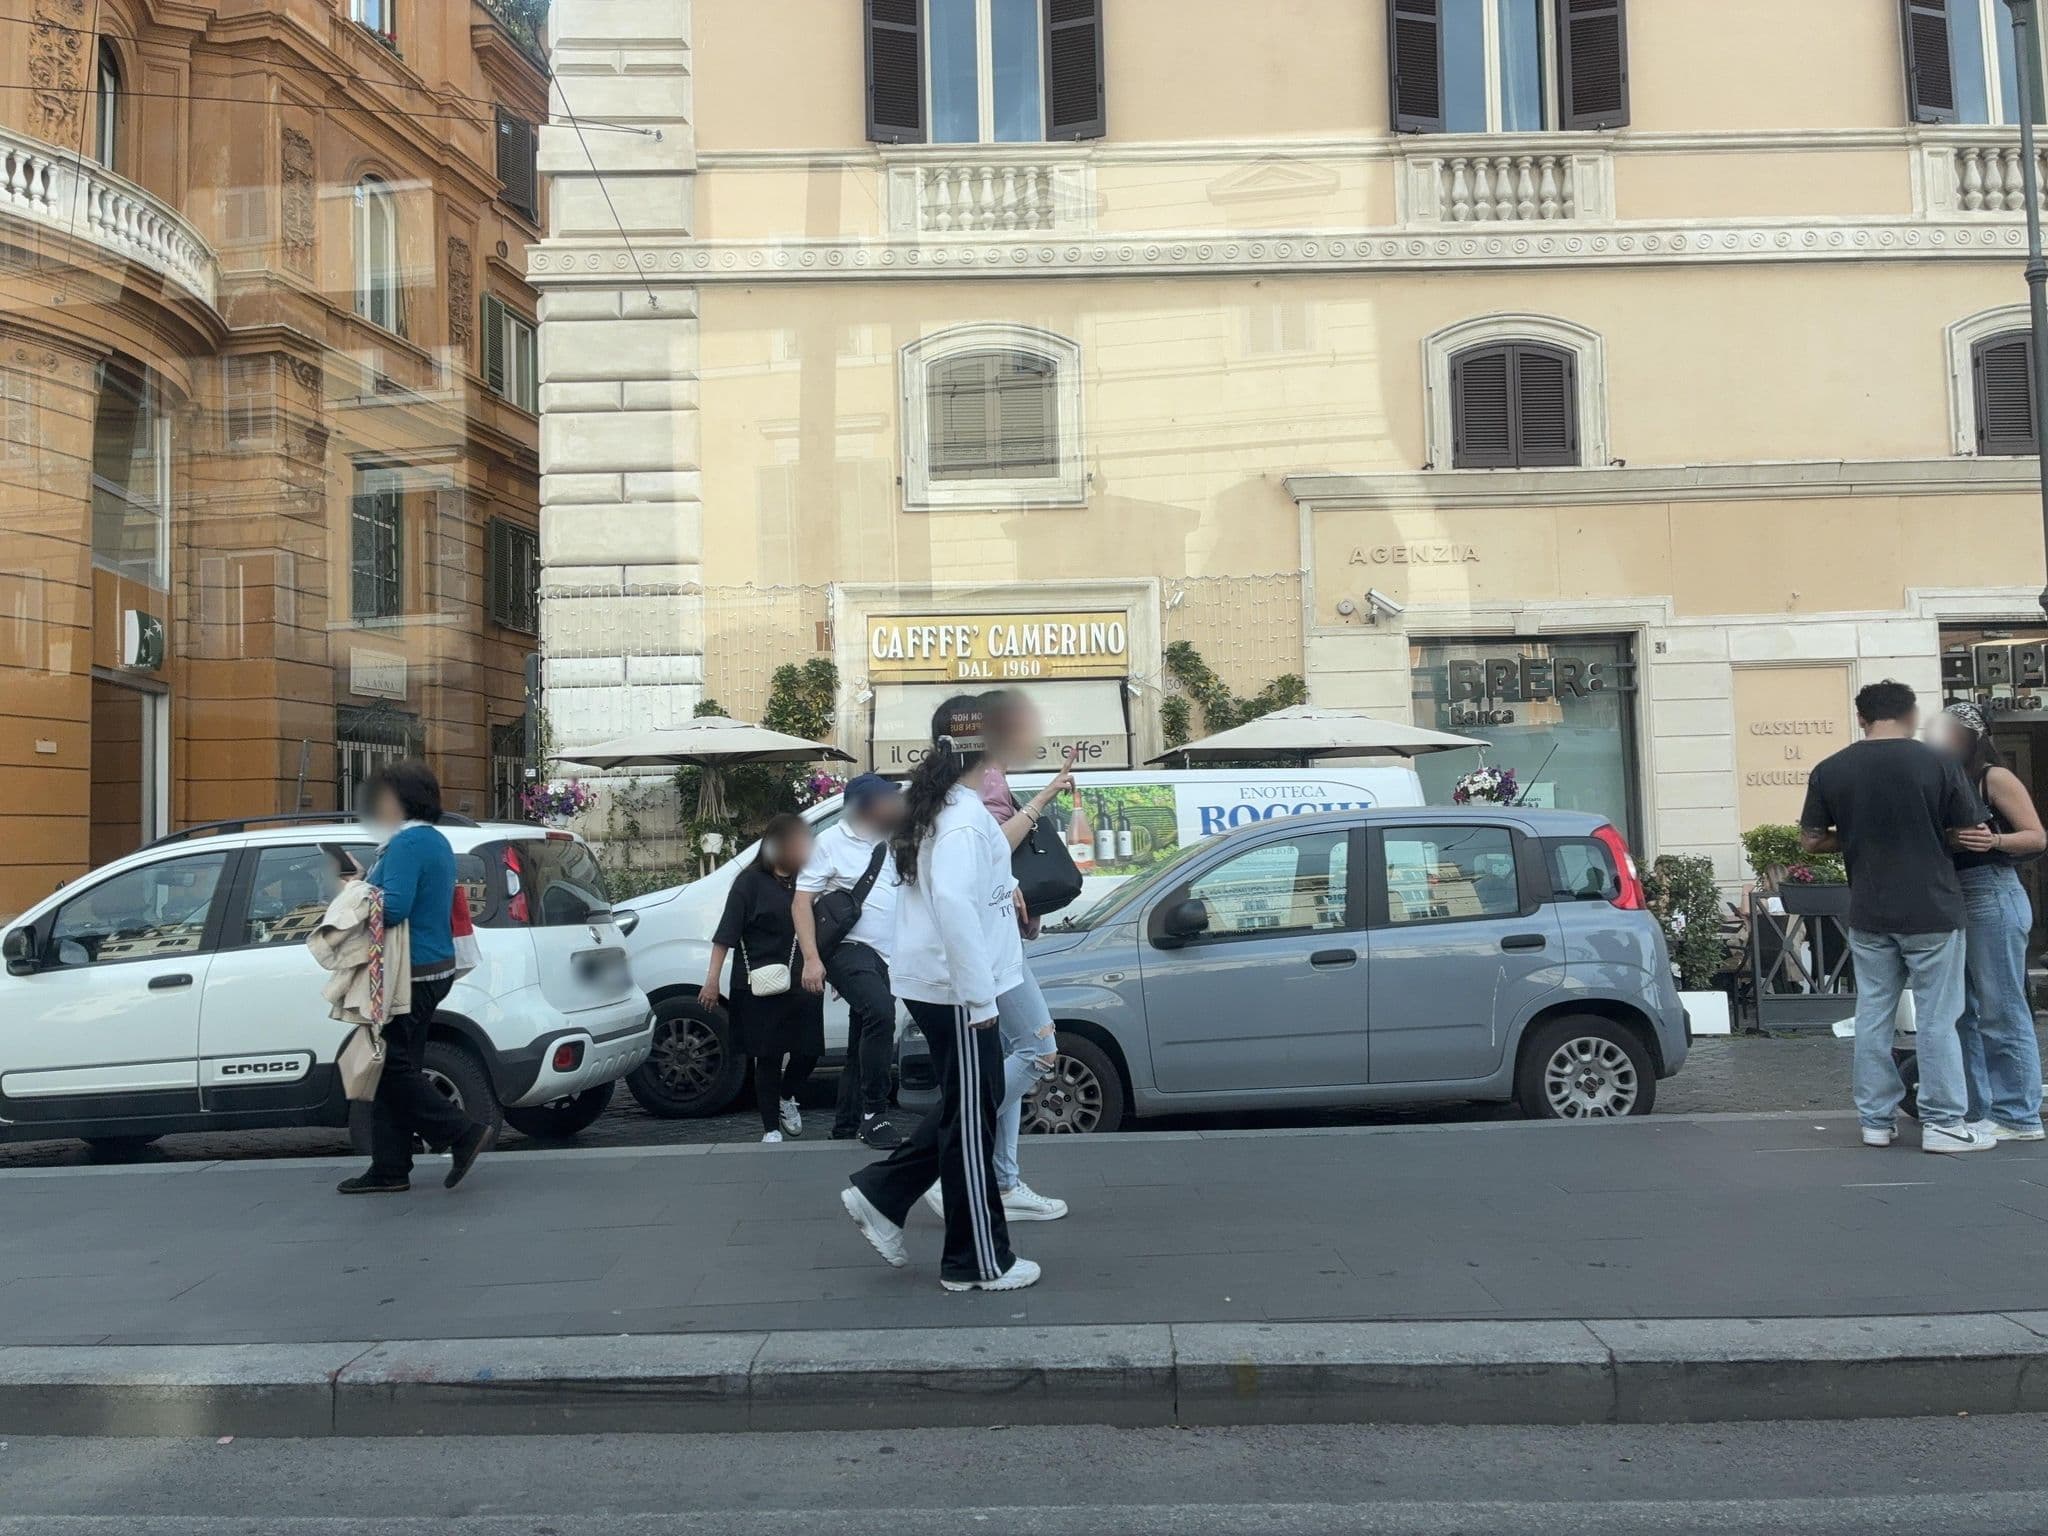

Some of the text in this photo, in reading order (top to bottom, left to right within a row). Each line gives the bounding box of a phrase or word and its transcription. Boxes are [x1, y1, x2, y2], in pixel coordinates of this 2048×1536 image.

[1348, 543, 1480, 566] AGENZIA
[986, 621, 1127, 658] CAMERINO
[957, 659, 1042, 678] DAL 1960
[1165, 679, 1182, 691] 30
[1448, 706, 1515, 727] Banca
[1750, 719, 1833, 736] CASSETTE
[891, 745, 903, 764] il
[1783, 744, 1801, 760] DI
[1239, 785, 1327, 800] ENOTECA
